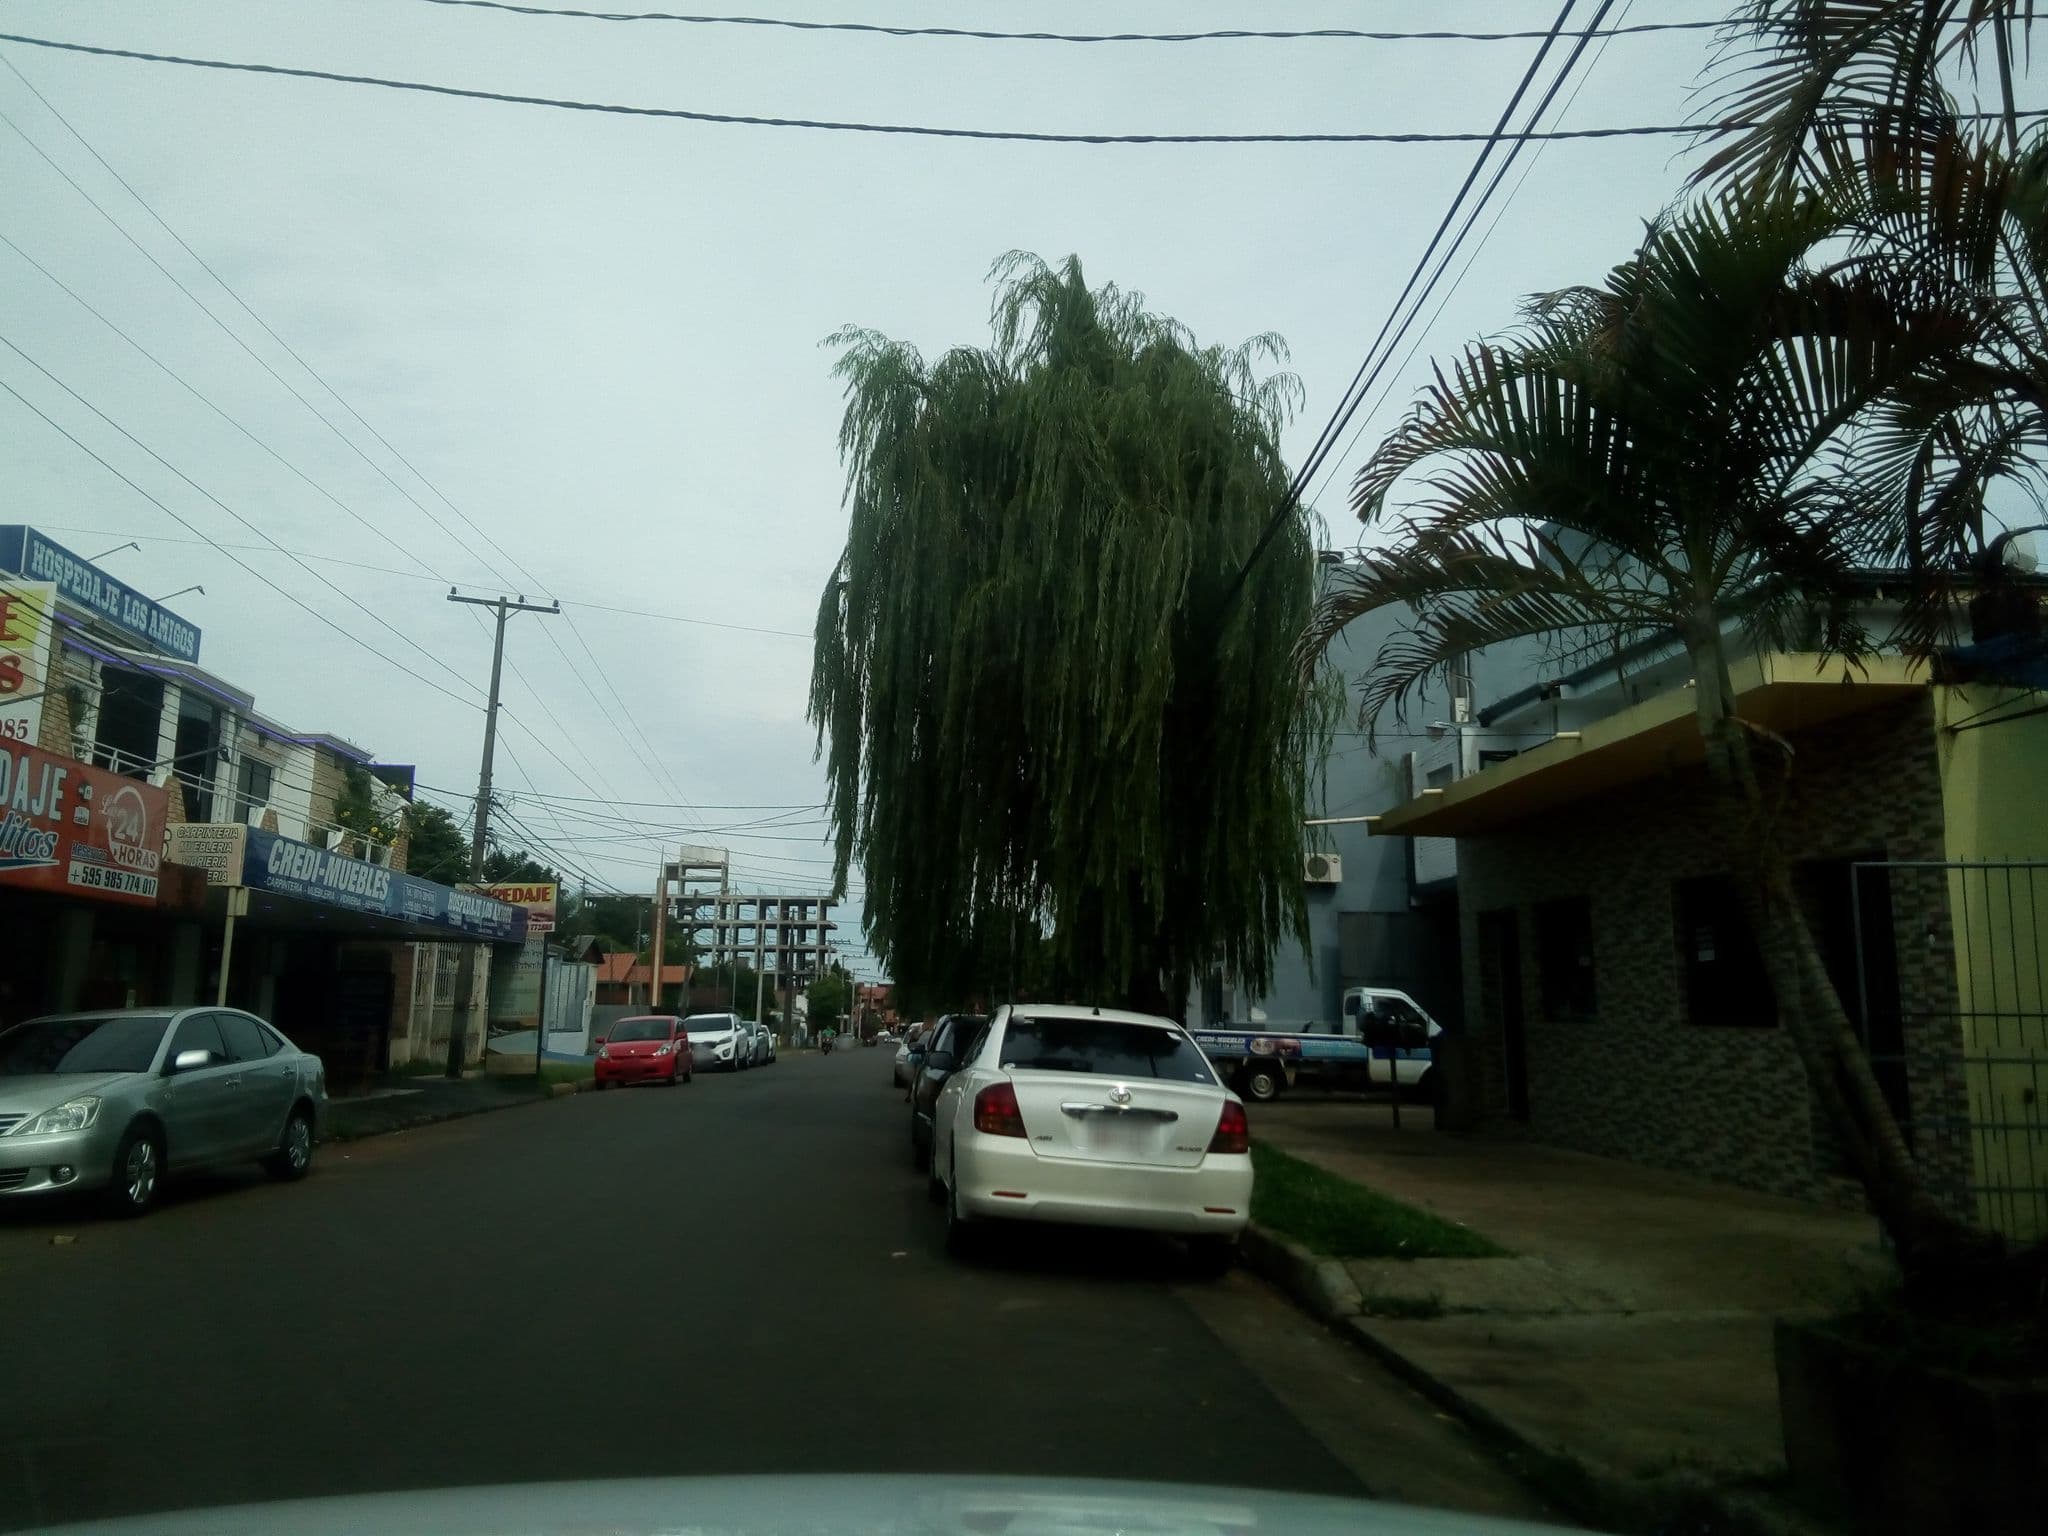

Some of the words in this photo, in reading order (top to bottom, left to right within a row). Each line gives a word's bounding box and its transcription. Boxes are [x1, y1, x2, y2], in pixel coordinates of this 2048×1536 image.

[31, 540, 120, 616] HOSPEDAJE
[122, 594, 149, 633] LOS
[148, 609, 195, 657] AMIGOS
[0, 749, 67, 821] DAJE
[177, 826, 238, 840] CARPINTERIA
[81, 865, 101, 886] 595
[104, 870, 122, 889] 985
[124, 874, 140, 892] 774
[142, 878, 157, 895] 017
[119, 844, 156, 870] HORAS
[267, 839, 391, 901] CREDI-MUEBLES
